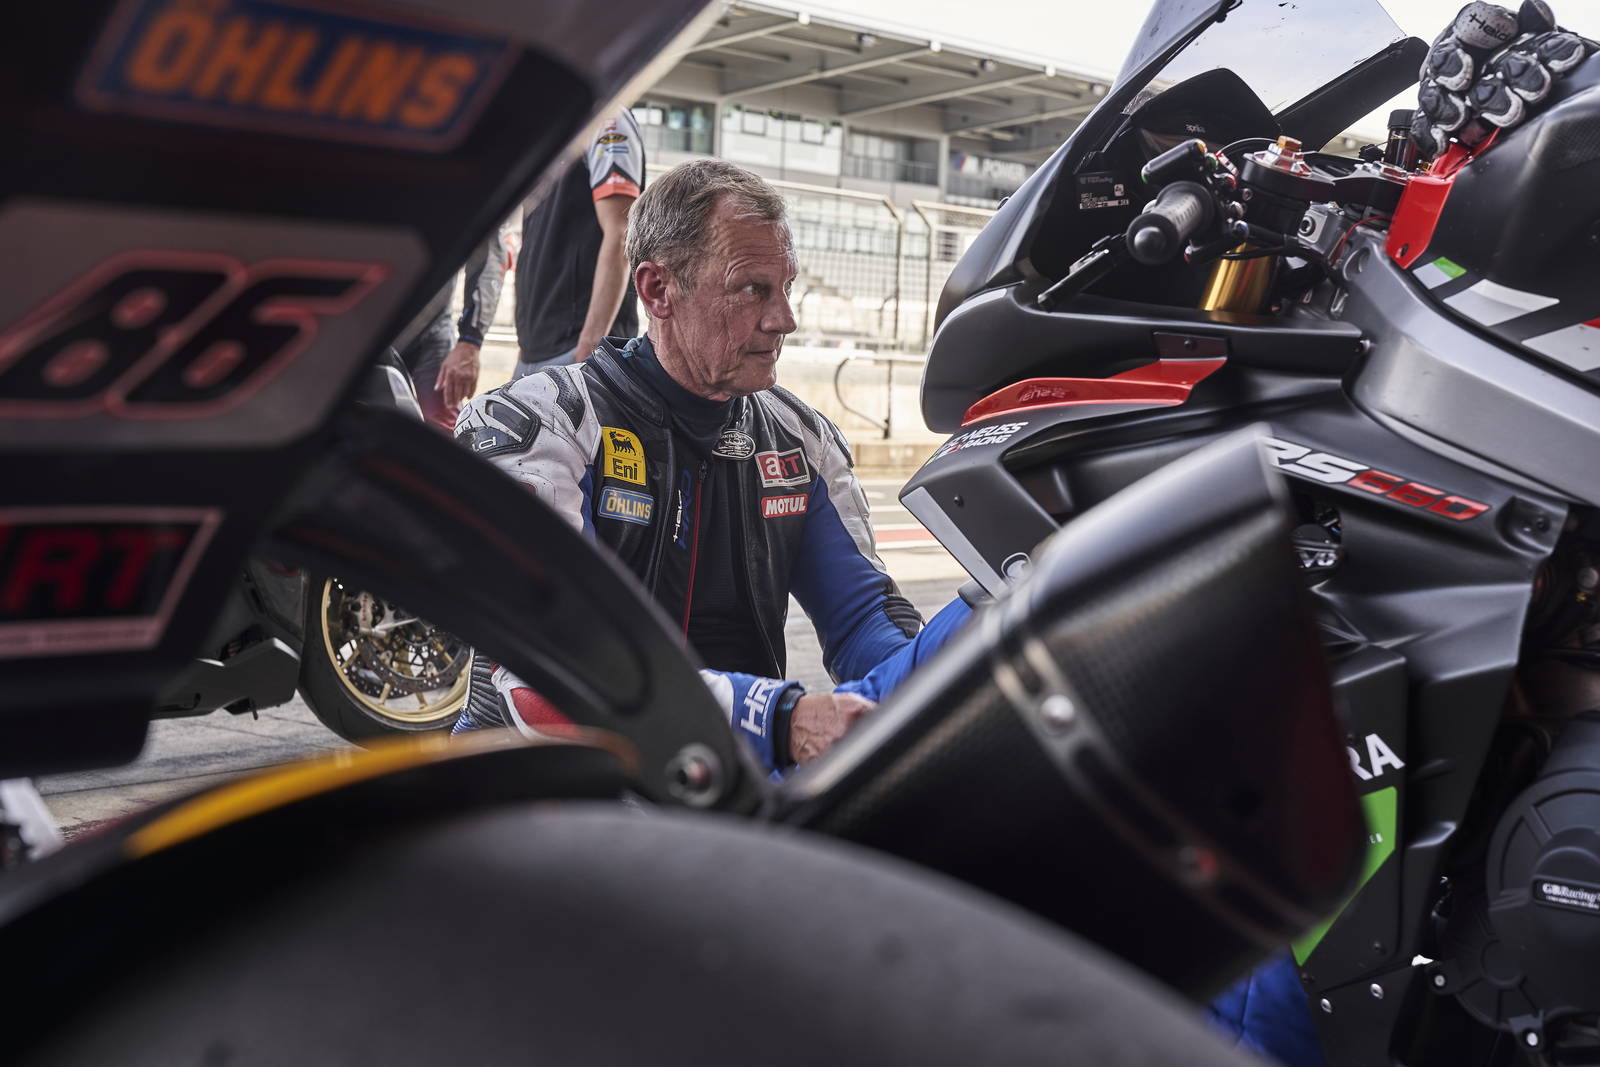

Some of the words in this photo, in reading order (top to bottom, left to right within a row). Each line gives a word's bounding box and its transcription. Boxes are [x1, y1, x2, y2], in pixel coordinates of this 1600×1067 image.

[0, 251, 392, 419] 86
[612, 458, 638, 480] Eni
[605, 491, 652, 520] ÖHLINS
[765, 496, 806, 515] MOTUL
